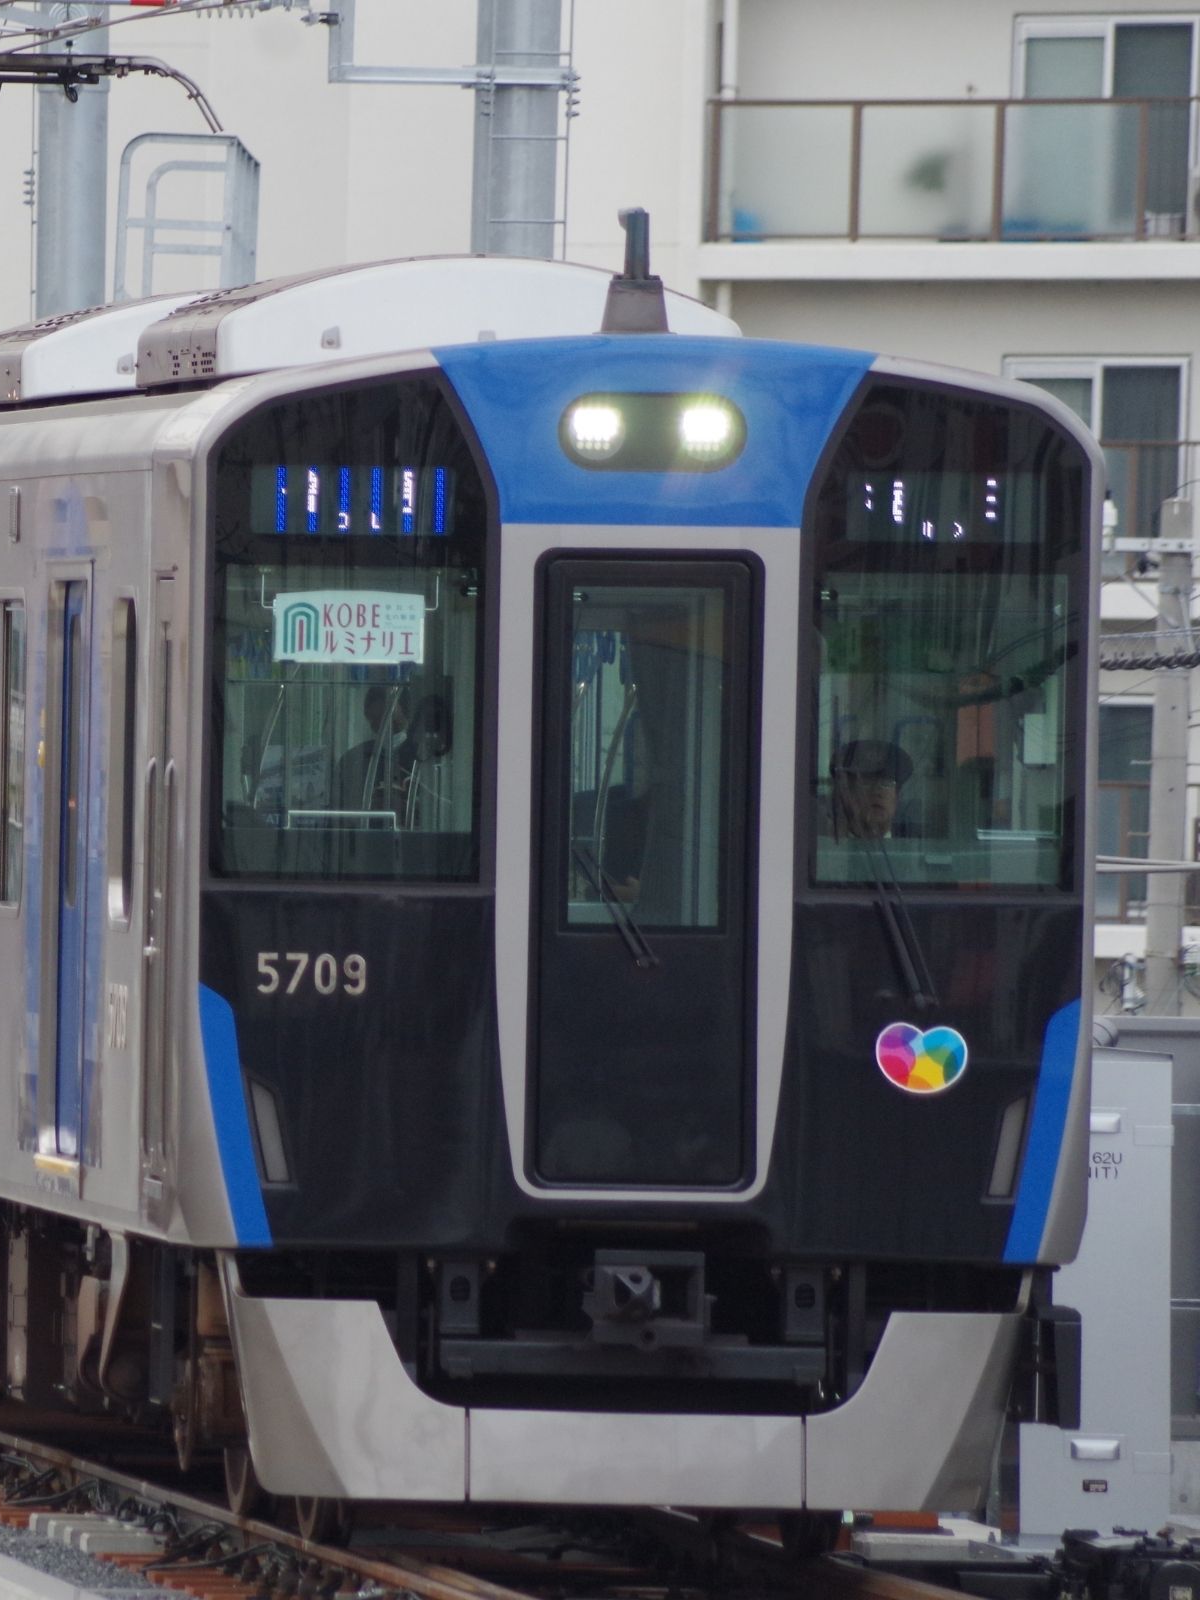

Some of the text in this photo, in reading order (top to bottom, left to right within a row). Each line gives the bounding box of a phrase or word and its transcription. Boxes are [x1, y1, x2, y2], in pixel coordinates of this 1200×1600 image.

[323, 603, 381, 628] KOBE
[323, 630, 415, 656] ルミナリエ
[257, 951, 368, 996] 5709
